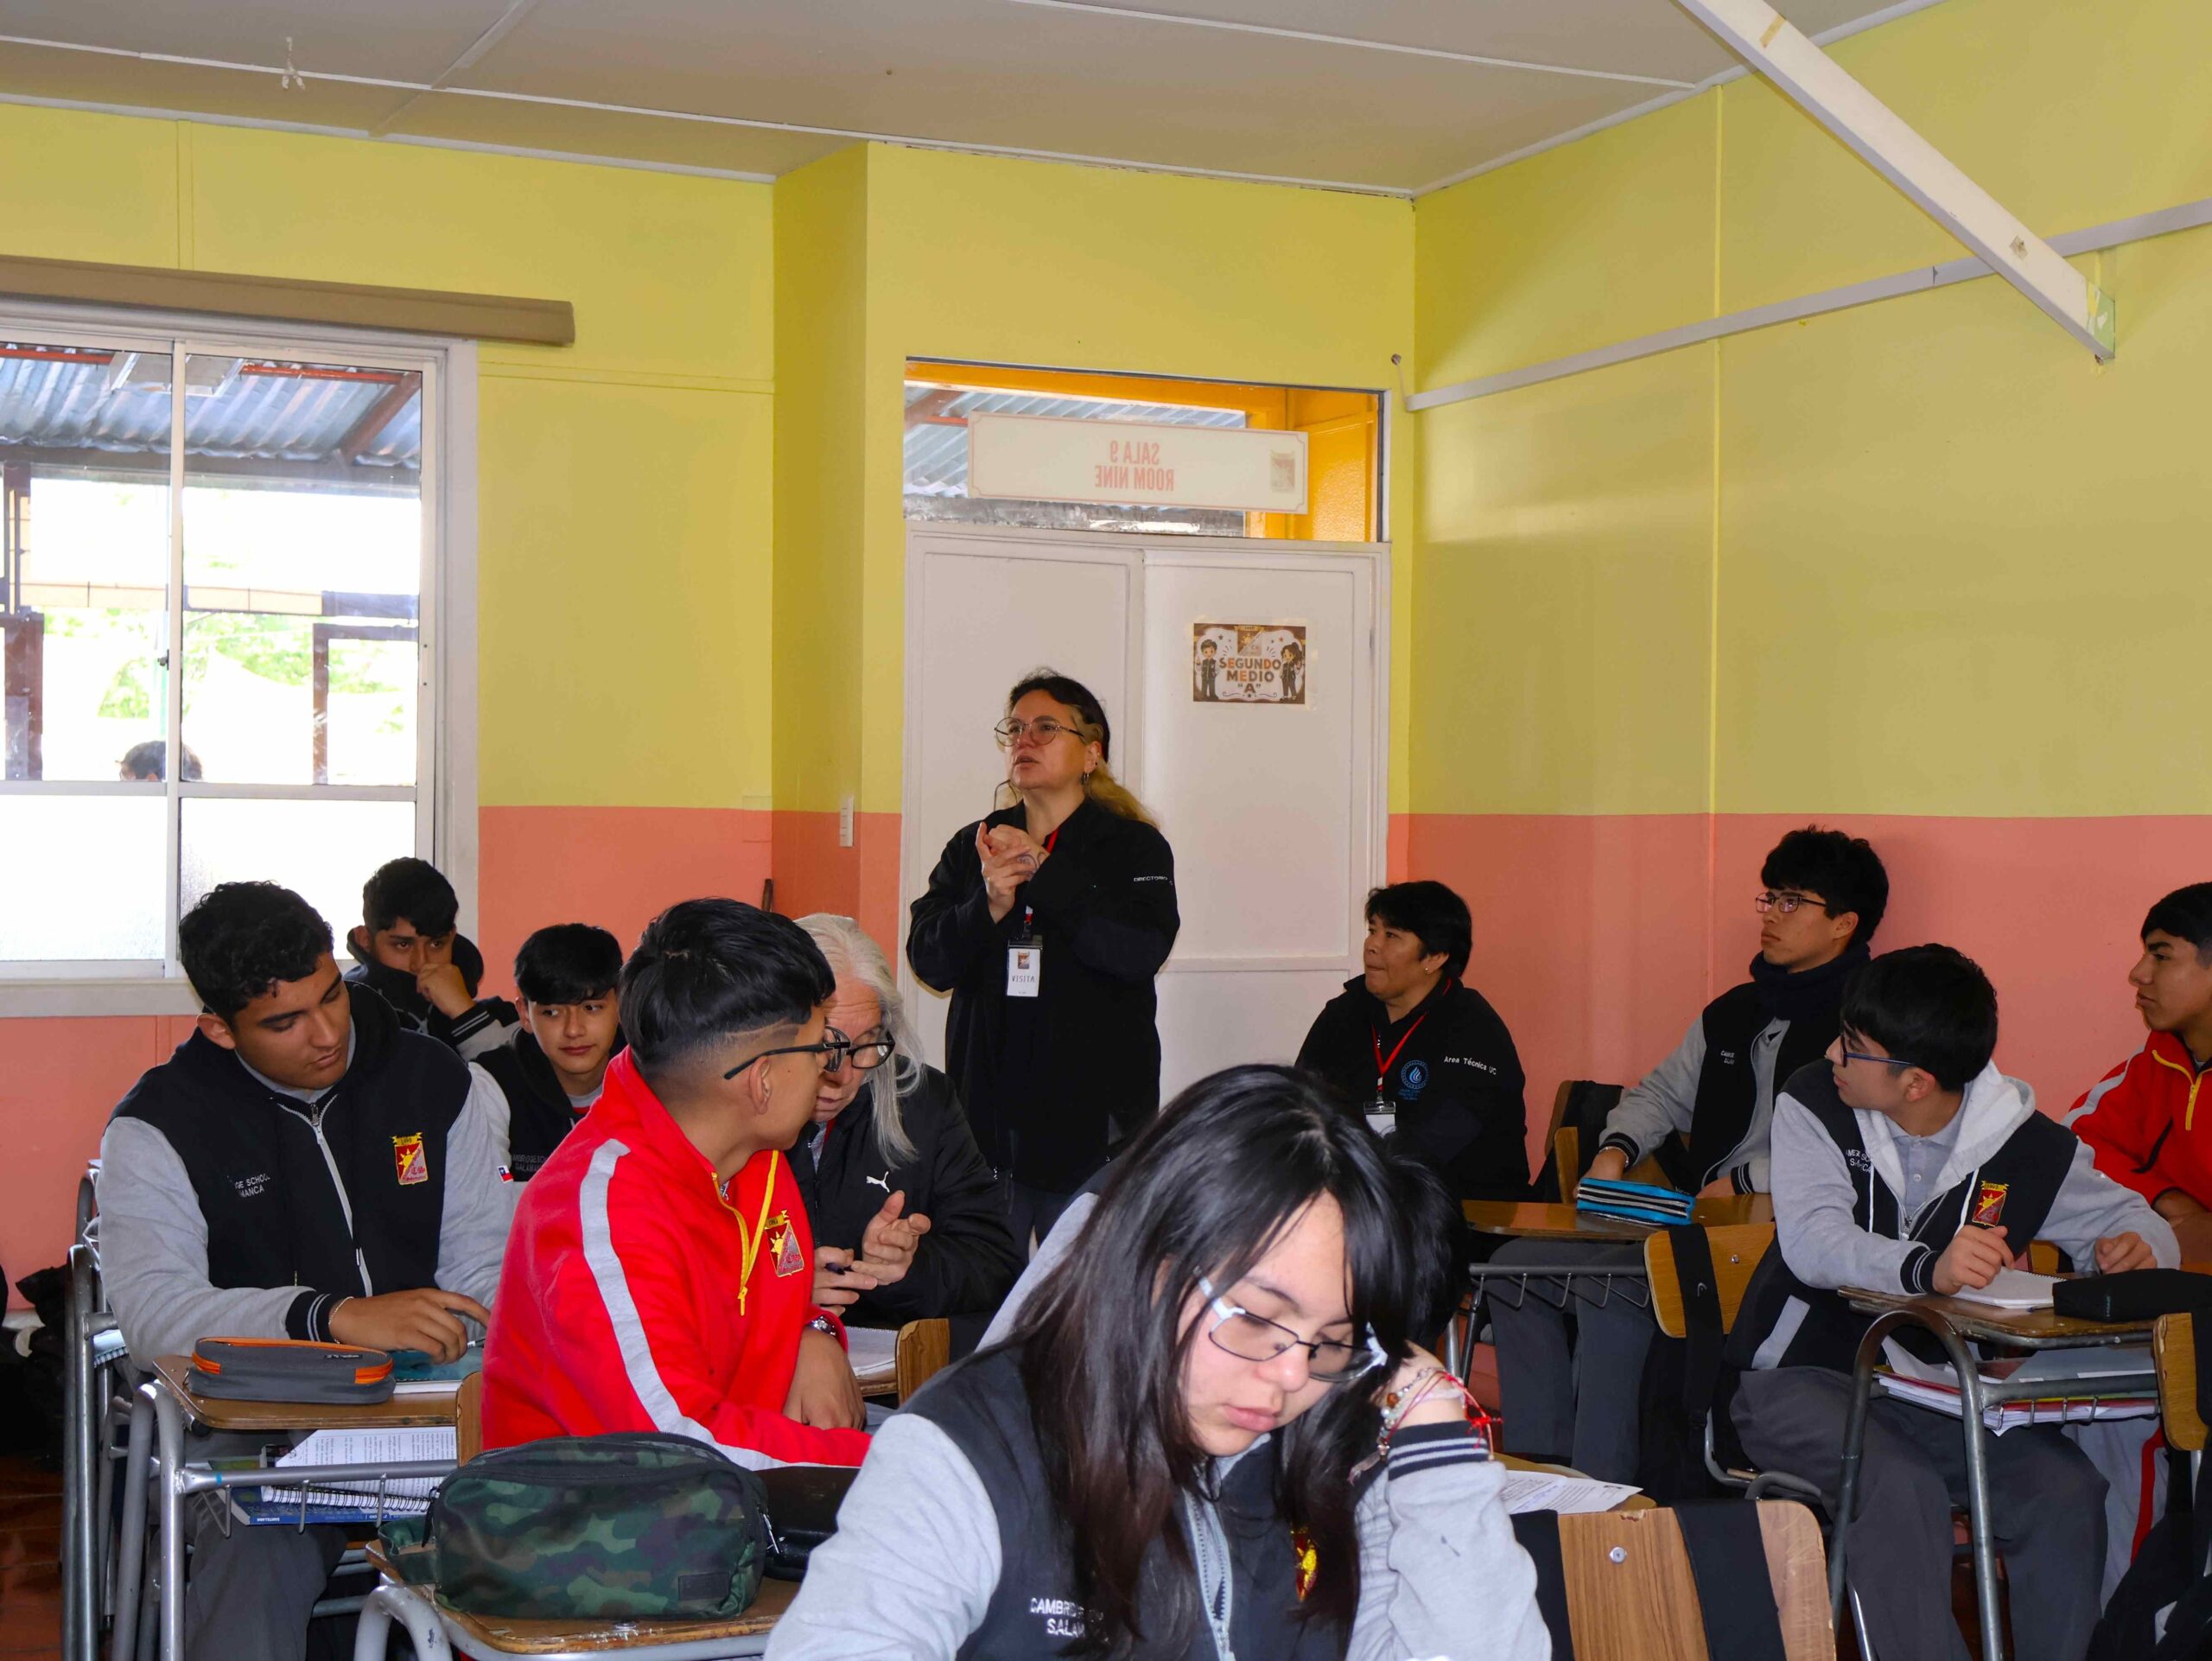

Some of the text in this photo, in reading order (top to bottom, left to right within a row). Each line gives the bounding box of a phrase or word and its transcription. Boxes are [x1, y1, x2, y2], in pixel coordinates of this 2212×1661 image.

[1219, 658, 1281, 670] SEGUNDO
[1226, 670, 1274, 682] MEDIO
[1463, 1057, 1487, 1071] Técnica
